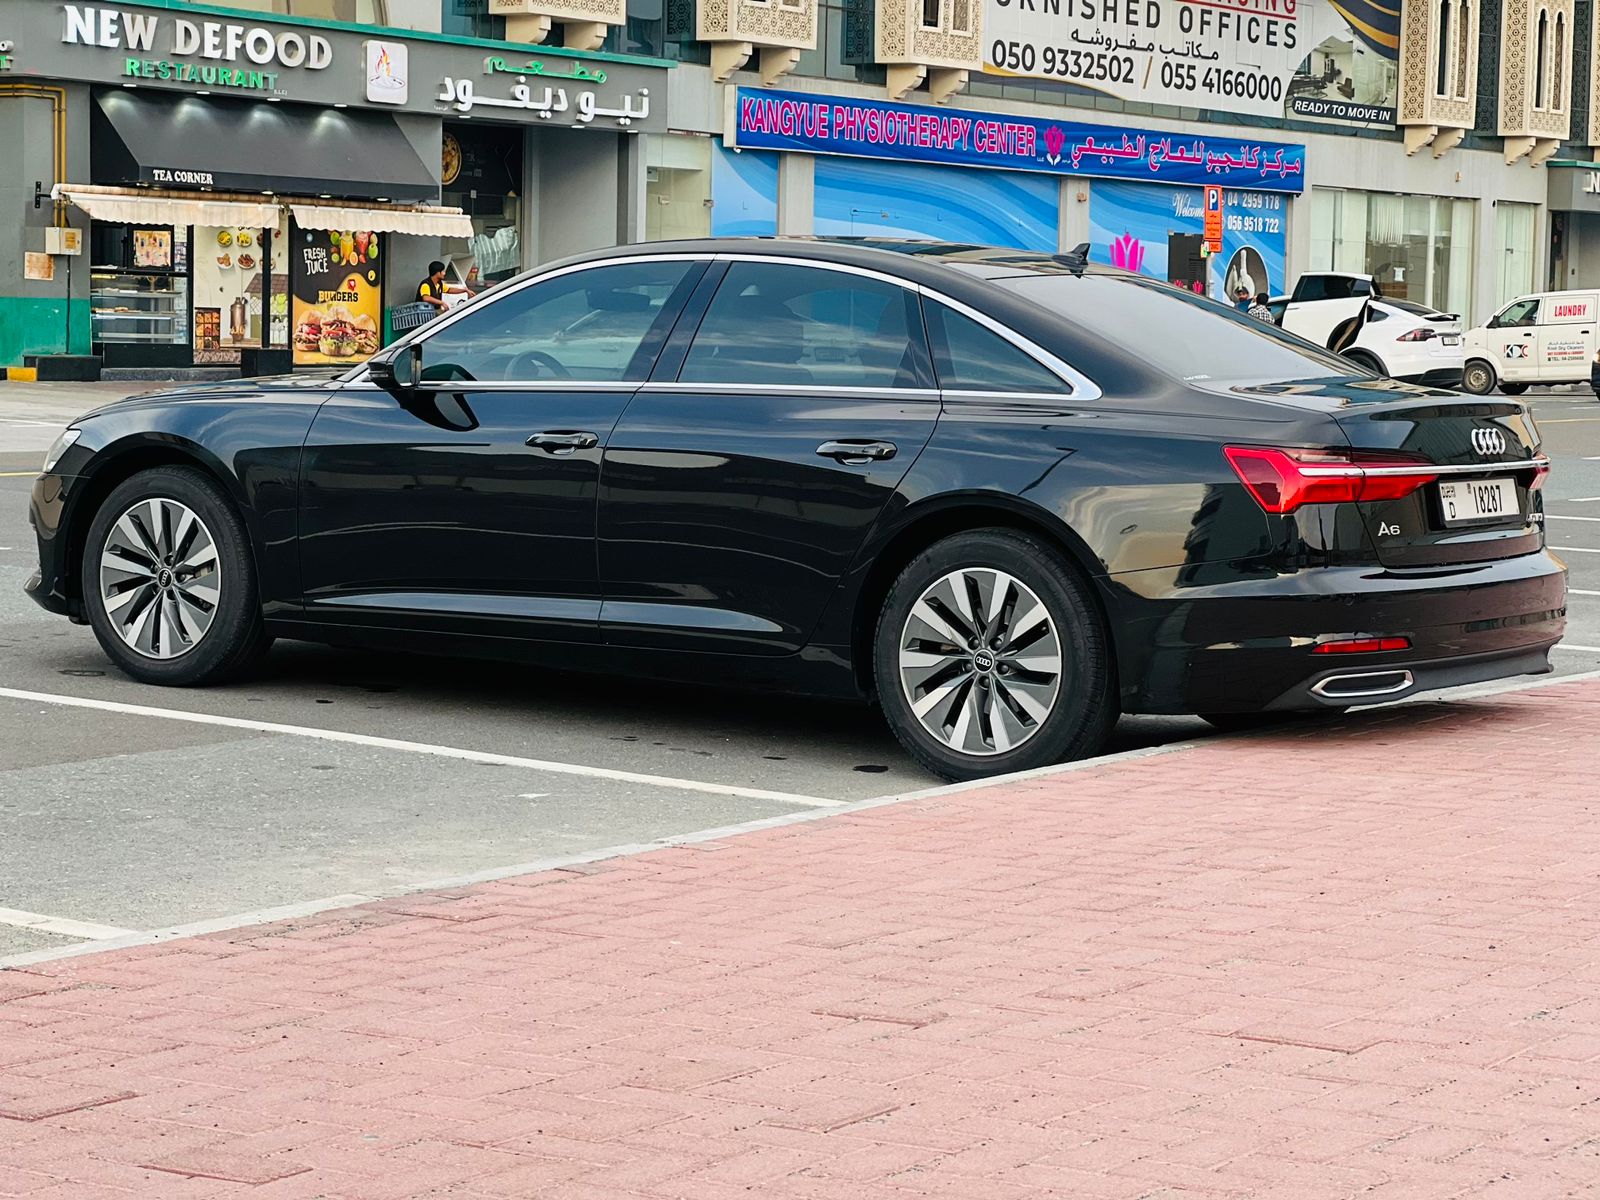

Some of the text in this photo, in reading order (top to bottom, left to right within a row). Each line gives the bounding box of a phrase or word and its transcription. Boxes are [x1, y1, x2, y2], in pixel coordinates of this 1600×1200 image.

[995, 0, 1297, 50] NISHED OFFICES
[63, 5, 333, 70] NEW DEFOOD
[1070, 28, 1219, 61] مكاتب مفروشه
[124, 56, 278, 90] RESTAURANT
[483, 56, 607, 84] مطعم
[992, 39, 1036, 72] 050
[1042, 46, 1134, 84] 9332502
[1161, 60, 1197, 91] 055
[1201, 67, 1282, 102] 4166000
[436, 75, 649, 126] نيو ديفود
[1294, 100, 1391, 121] READY TO MOVE IN
[741, 96, 1037, 157] KANGYUE PHYSIOTHERAPY CENTER
[1071, 133, 1301, 179] مركز كانجيو للعلاج الطبيعي
[153, 169, 214, 184] TEA CORNER
[1209, 189, 1218, 210] P
[1227, 192, 1280, 210] 04 2959 178
[1227, 215, 1280, 233] 056 9518 722
[303, 247, 327, 261] FRESH
[304, 258, 329, 276] JUICE
[318, 290, 359, 302] BURGERS
[1554, 304, 1587, 317] LAUNDRY
[1473, 485, 1503, 514] 18287
[1377, 521, 1401, 537] A6
